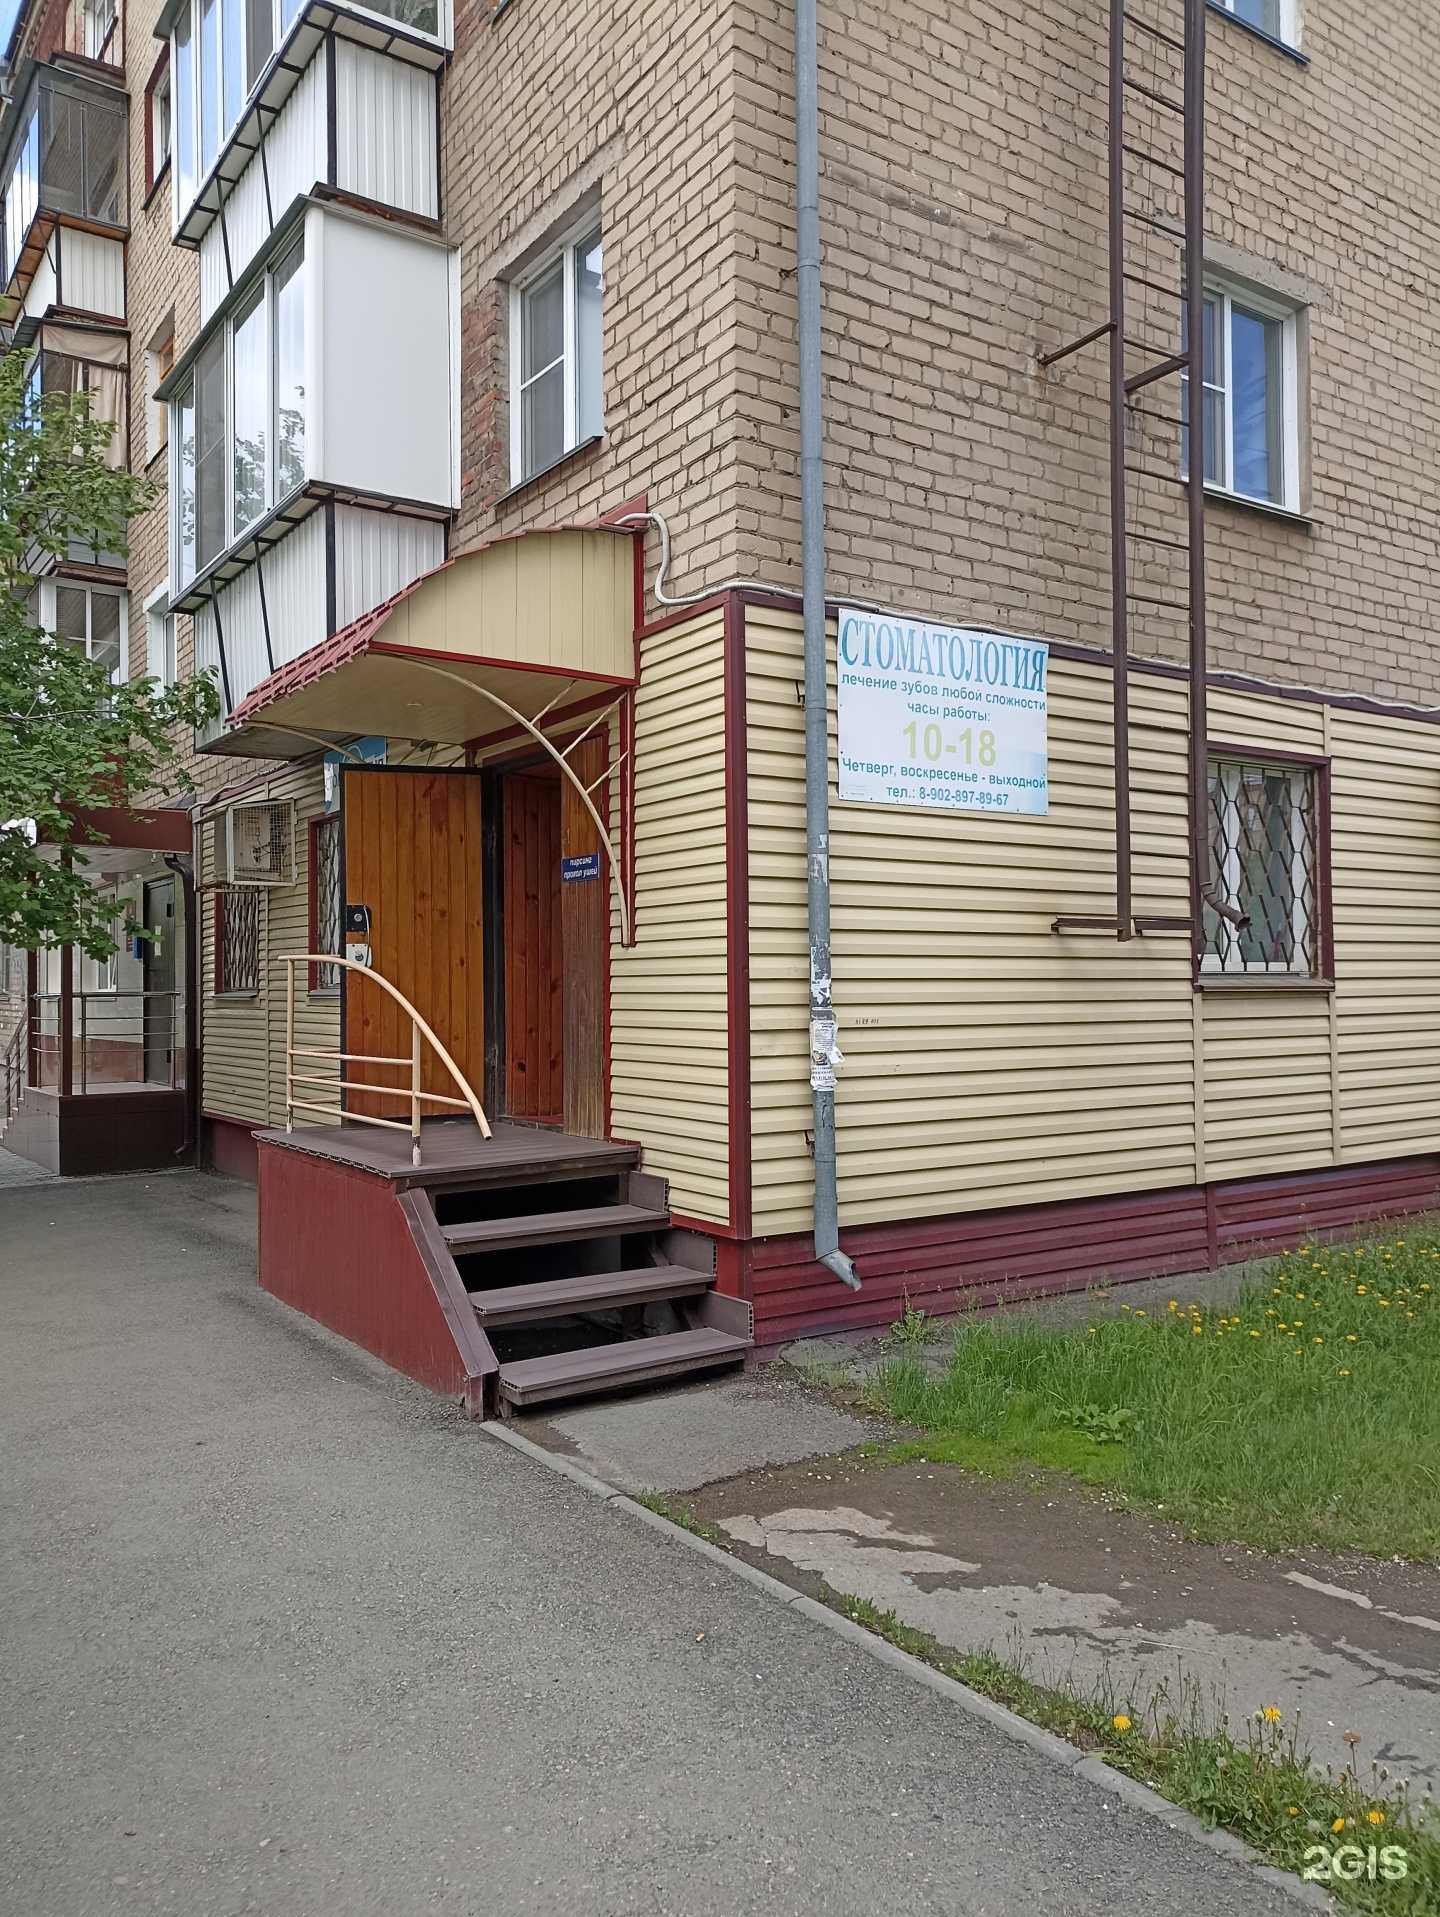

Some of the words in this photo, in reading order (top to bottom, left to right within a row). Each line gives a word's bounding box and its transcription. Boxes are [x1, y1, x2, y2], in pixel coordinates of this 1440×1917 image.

[841, 617, 1046, 692] СТОМАТОЛОГИЯ
[841, 674, 897, 690] лечение
[901, 681, 938, 696] зубов
[941, 685, 982, 702] любой
[985, 693, 1046, 711] сложности
[907, 702, 939, 716] часы
[943, 706, 991, 721] работы:
[903, 720, 996, 767] 10-18
[842, 757, 897, 776] Четверг,
[901, 765, 978, 782] воскресенье
[989, 774, 1046, 789] выходной
[887, 785, 915, 798] тел.:
[919, 786, 1009, 805] 8-902-897-89-67
